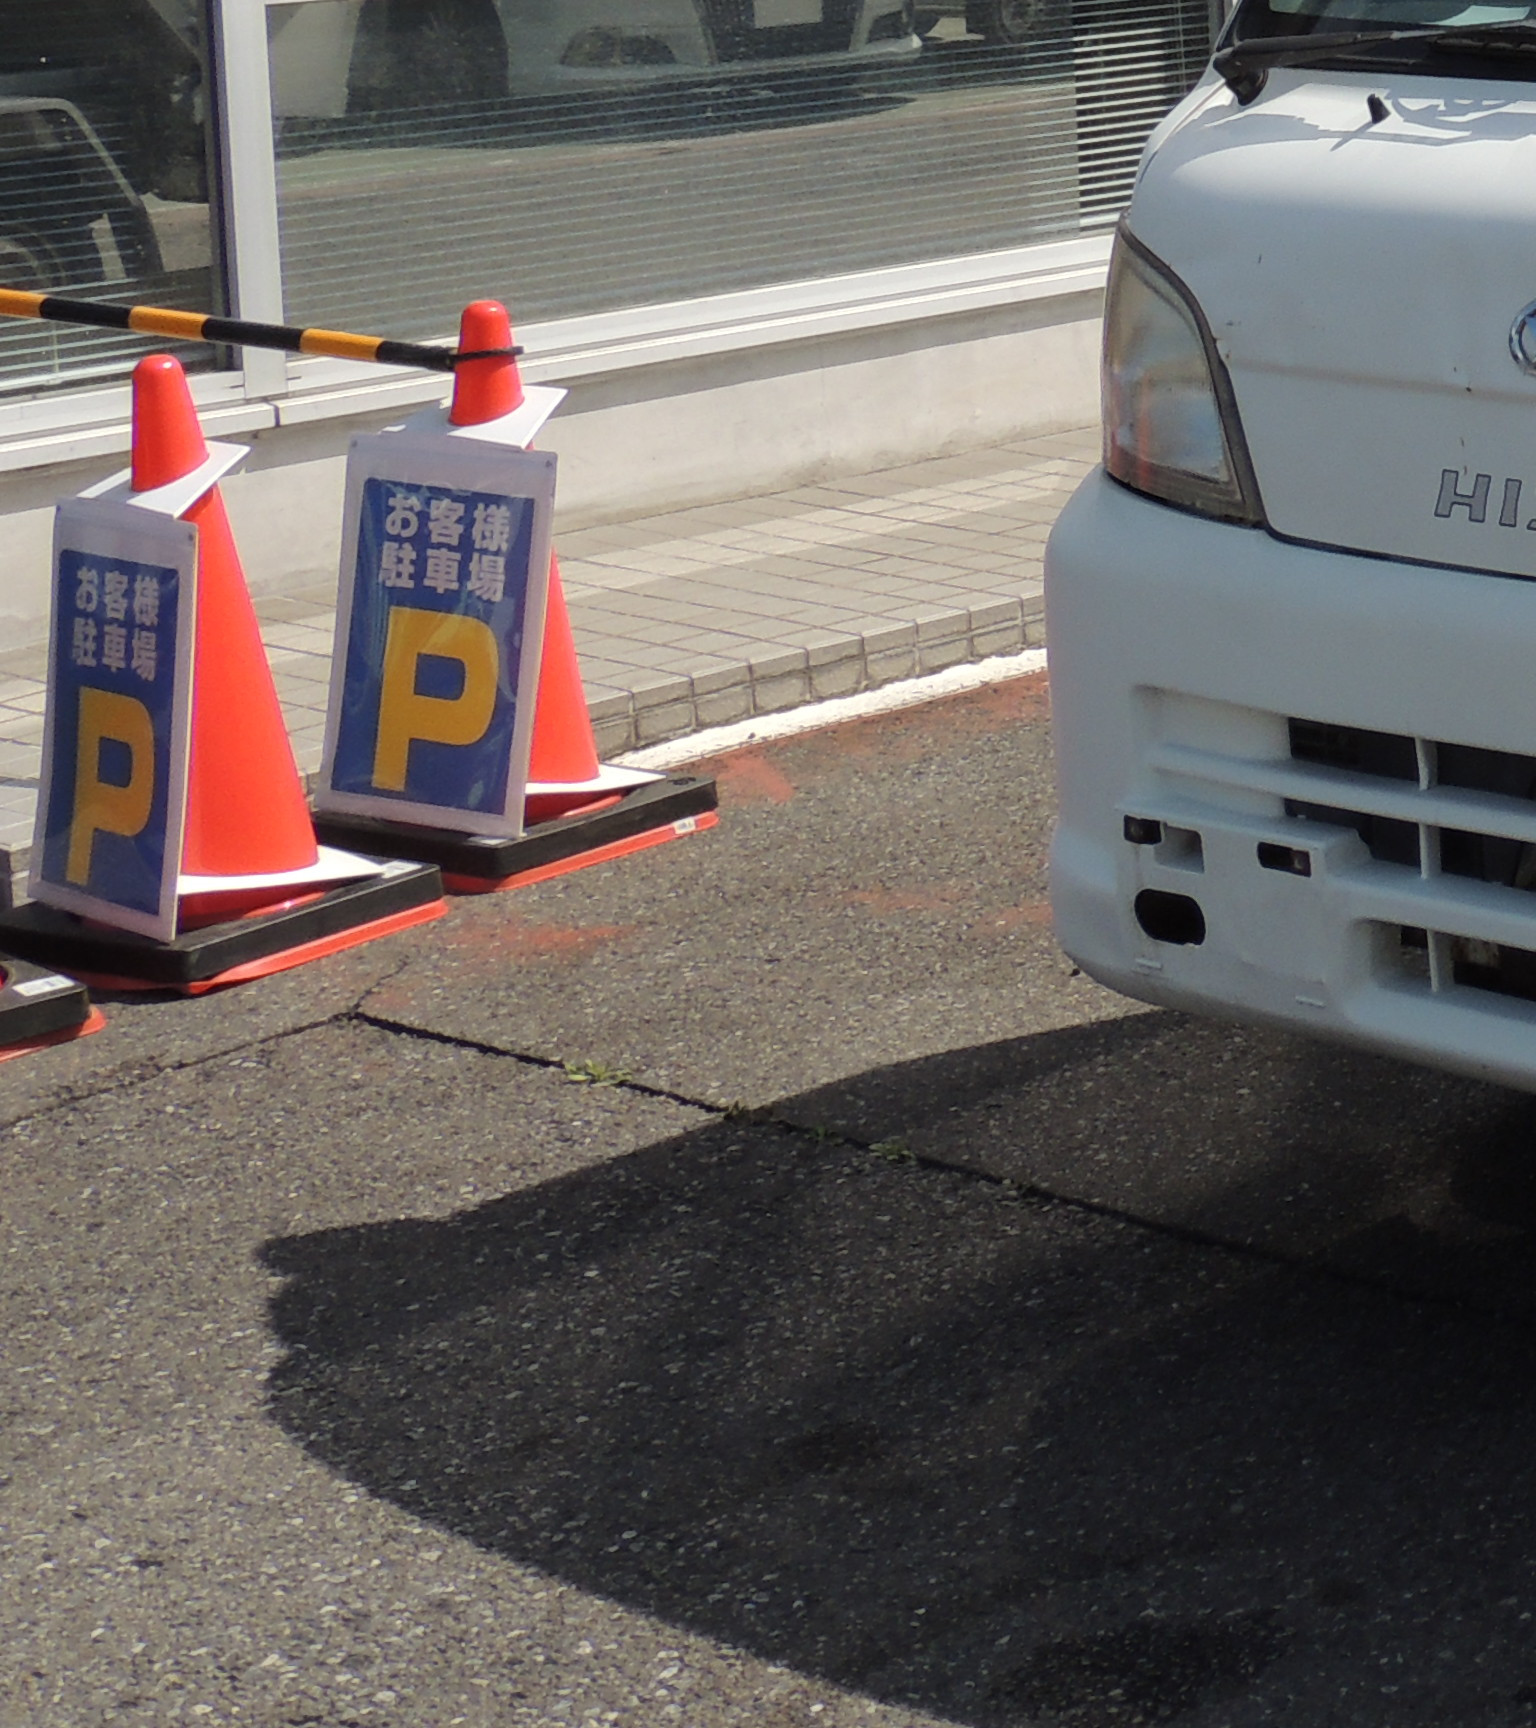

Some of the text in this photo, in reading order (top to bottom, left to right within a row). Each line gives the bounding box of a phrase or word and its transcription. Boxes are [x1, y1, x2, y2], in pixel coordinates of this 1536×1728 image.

[386, 494, 511, 552] お客様
[76, 566, 160, 627] お客様
[379, 541, 506, 602] 駐車場
[72, 617, 157, 681] 駐車場
[371, 605, 498, 792] P
[66, 686, 155, 886] P
